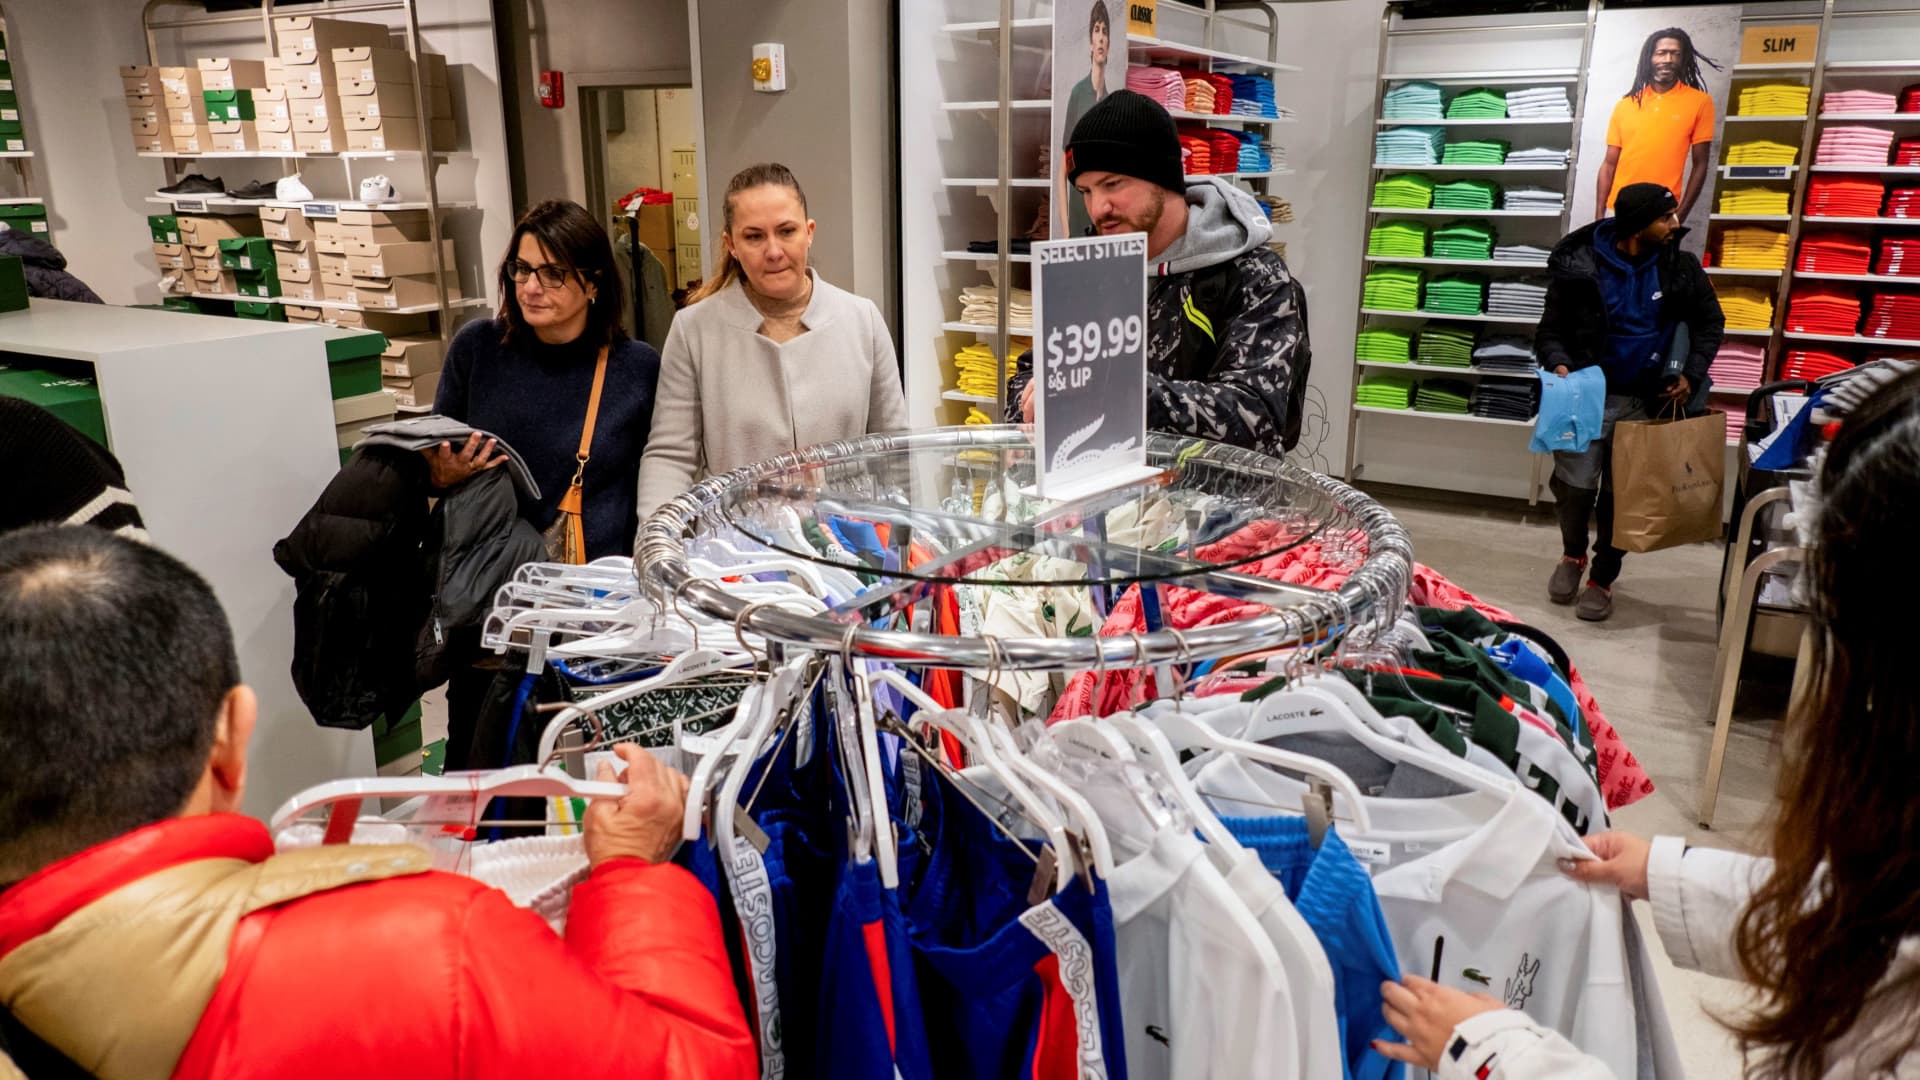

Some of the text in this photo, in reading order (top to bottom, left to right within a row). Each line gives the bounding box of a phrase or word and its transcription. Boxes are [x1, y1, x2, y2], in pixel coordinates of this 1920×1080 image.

[1762, 37, 1796, 53] SLIM
[1041, 240, 1145, 265] SELECT STYLES
[1047, 314, 1142, 374] $39.99
[1070, 366, 1092, 389] UP
[1265, 711, 1306, 723] LACOSTE
